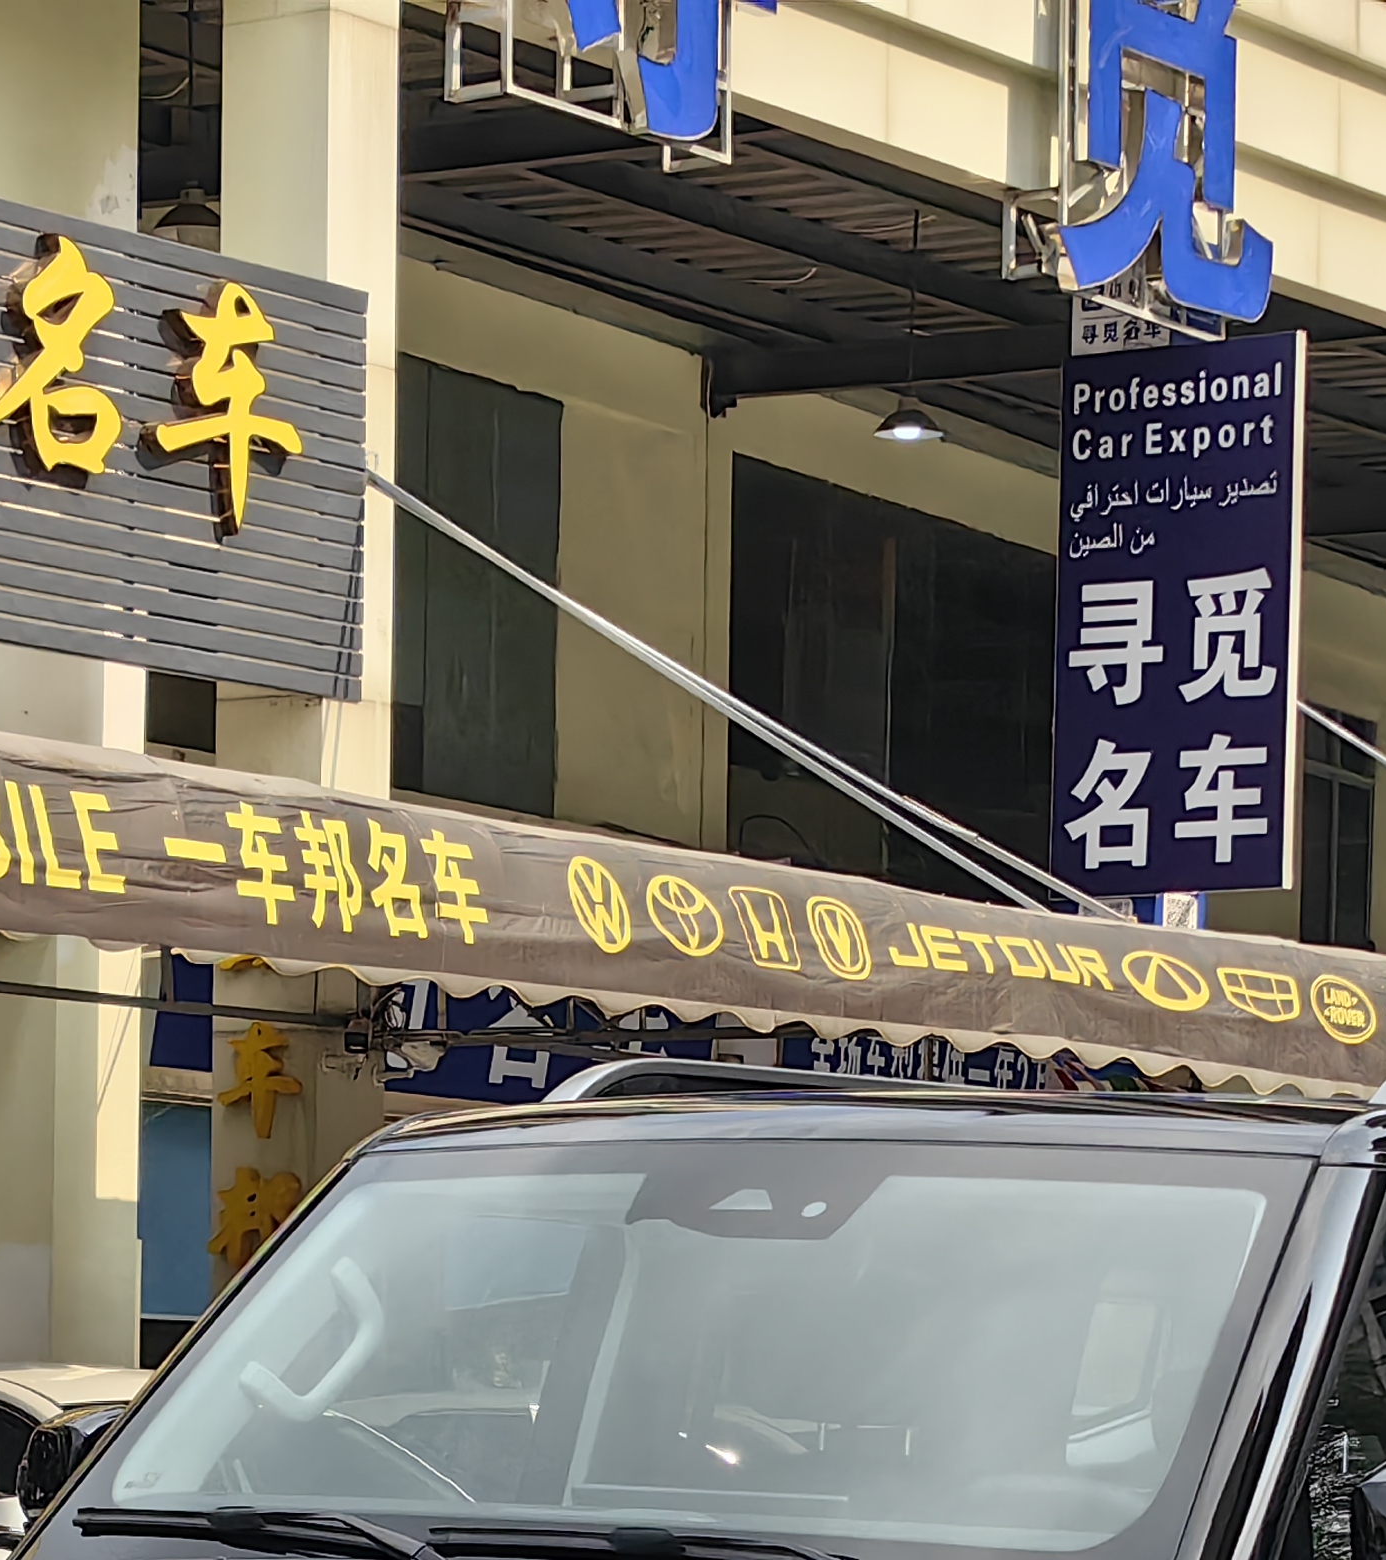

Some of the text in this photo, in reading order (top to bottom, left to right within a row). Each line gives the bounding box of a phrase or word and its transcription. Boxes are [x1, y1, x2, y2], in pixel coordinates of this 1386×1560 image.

[1072, 361, 1283, 415] Professional
[1072, 415, 1275, 462] Car Export
[1146, 476, 1213, 510] سيارات
[1218, 471, 1278, 507] تصدير
[1069, 522, 1156, 558] من الصين
[1068, 567, 1277, 706] 寻觅
[1064, 734, 1268, 870] 名车
[163, 801, 488, 945] 一车邦名车
[888, 922, 1115, 991] JETOUR
